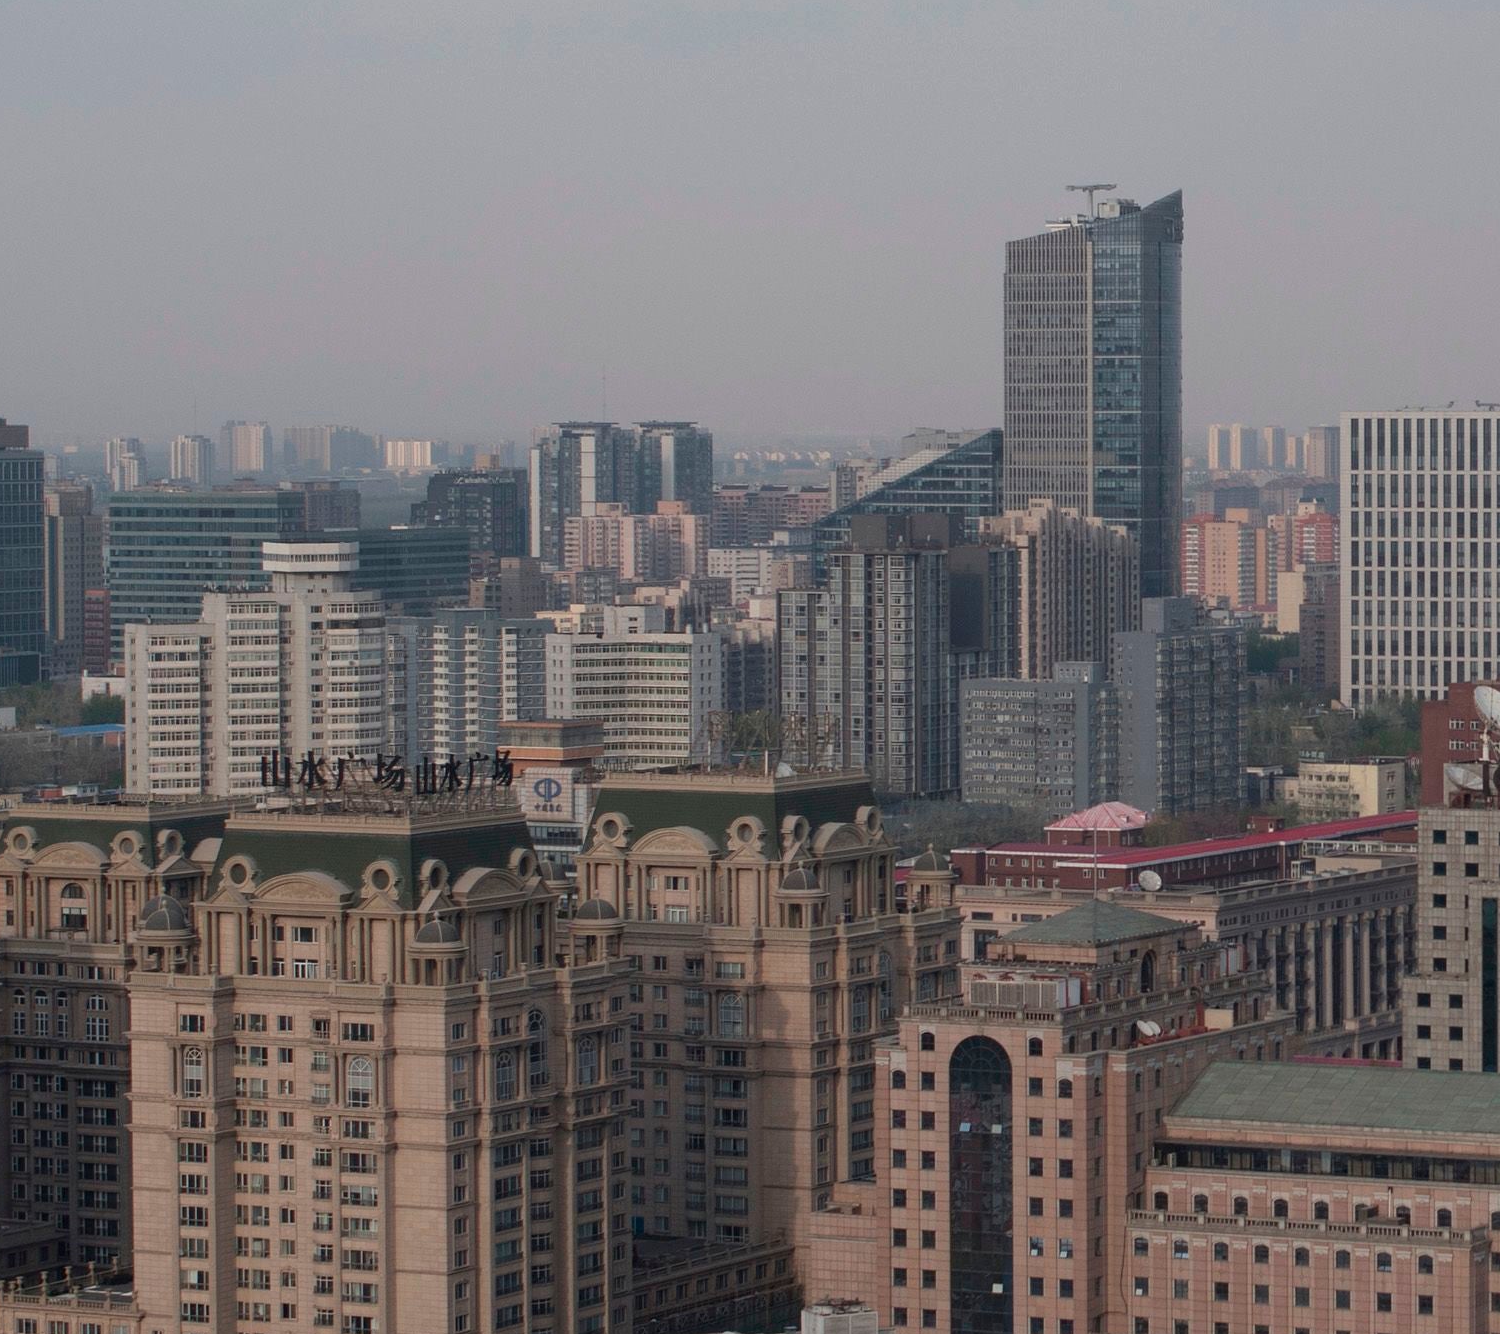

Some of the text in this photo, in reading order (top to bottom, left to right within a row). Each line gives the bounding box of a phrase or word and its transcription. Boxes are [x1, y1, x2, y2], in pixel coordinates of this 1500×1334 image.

[261, 749, 514, 795] 山水广场 山水广场
